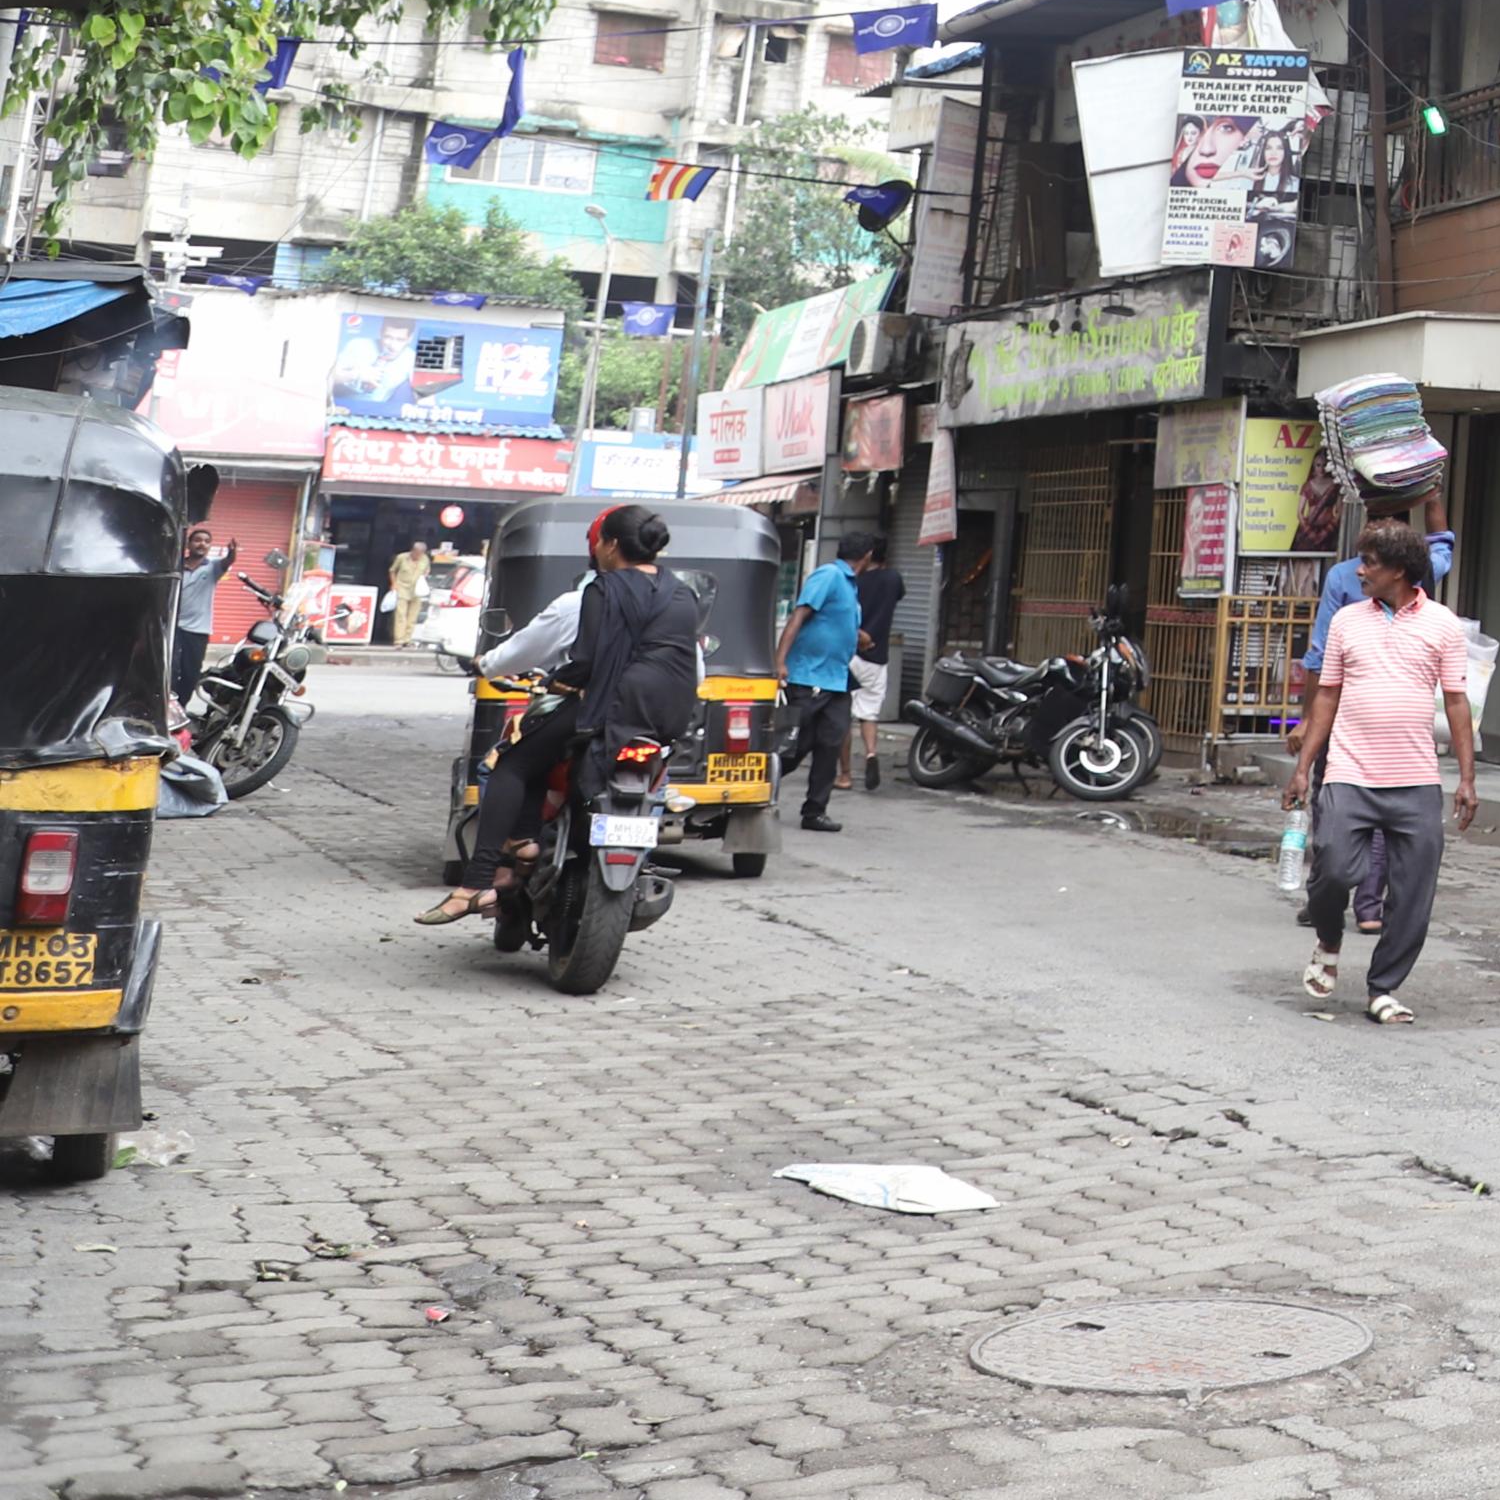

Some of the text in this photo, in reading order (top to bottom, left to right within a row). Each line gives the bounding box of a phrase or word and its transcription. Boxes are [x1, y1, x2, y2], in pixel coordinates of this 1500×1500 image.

[1215, 52, 1308, 68] AZ TATTOO
[1226, 67, 1278, 77] STUDIO
[1183, 80, 1304, 94] PERMANENT MAKEUP
[1192, 91, 1292, 104] TRAINING CENTRE
[1194, 102, 1288, 115] BEAUTY PARLOR
[1273, 424, 1316, 449] AZ
[397, 433, 445, 467] डेरी
[449, 438, 511, 470] फार्म
[709, 767, 766, 784] 2601
